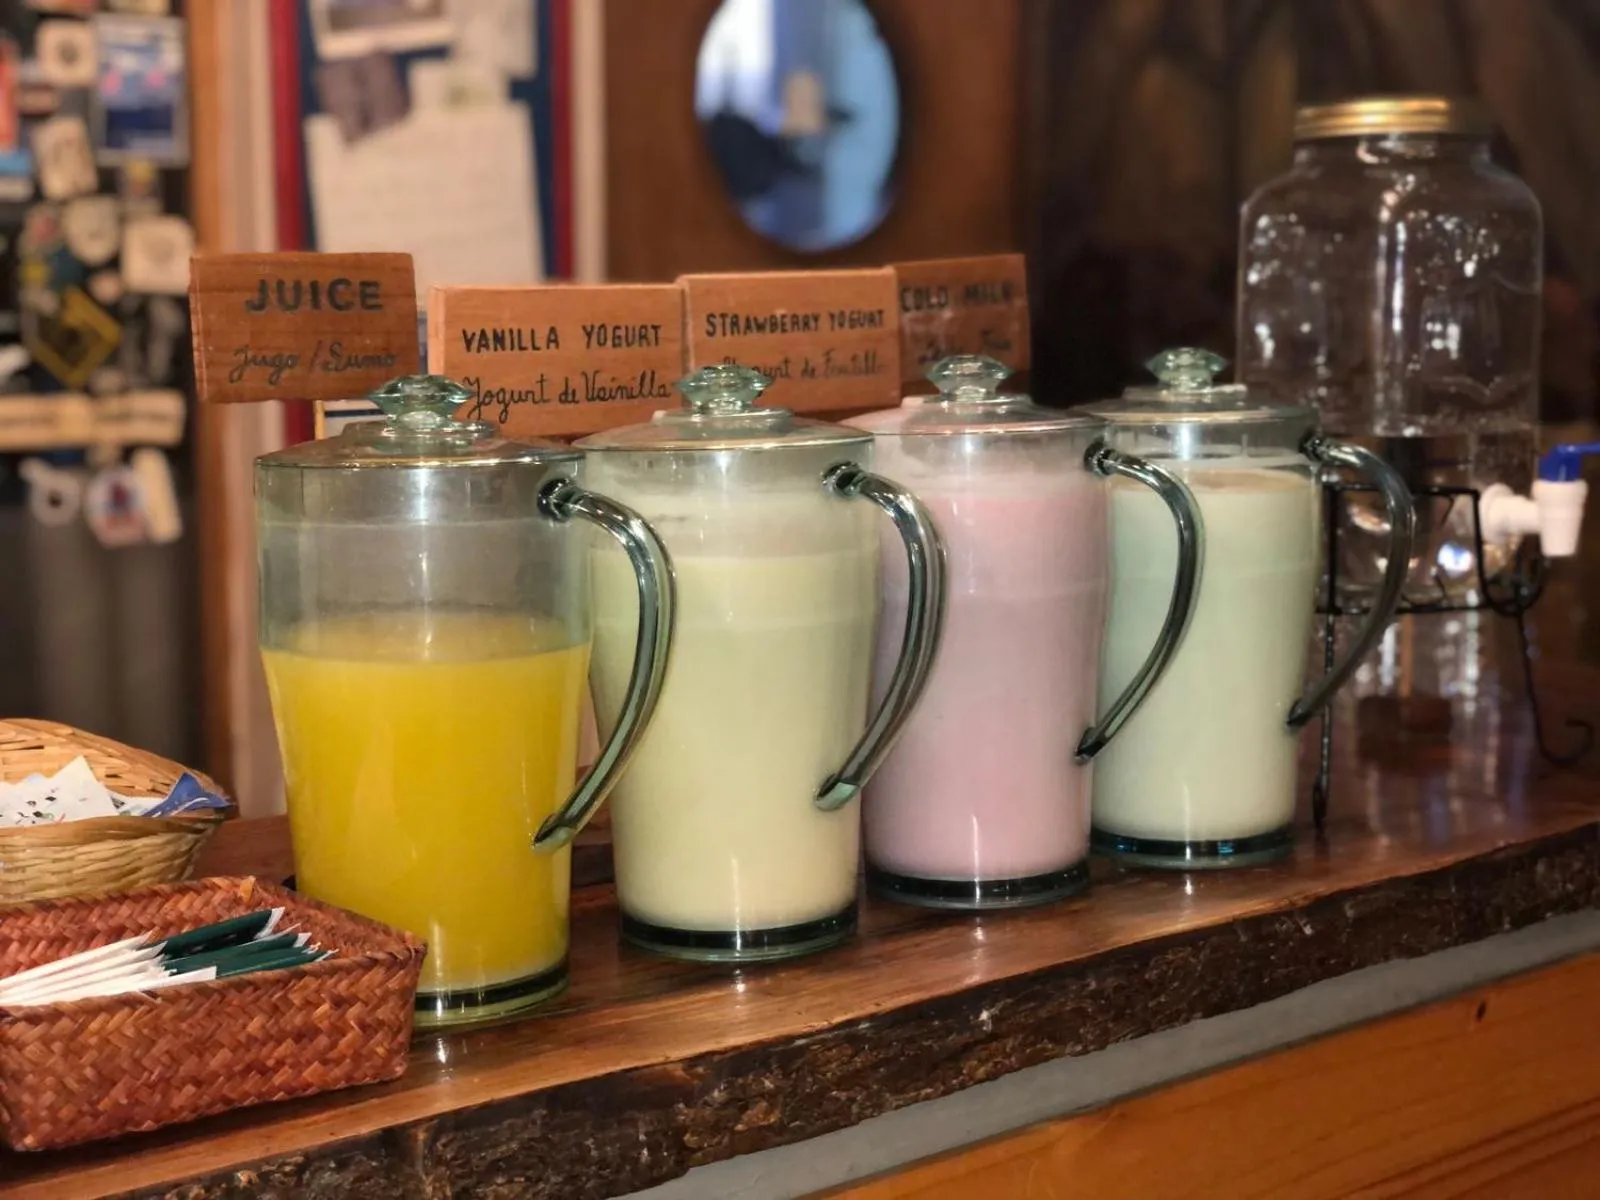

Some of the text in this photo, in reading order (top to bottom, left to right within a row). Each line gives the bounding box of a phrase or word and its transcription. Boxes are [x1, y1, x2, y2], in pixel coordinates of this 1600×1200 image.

[245, 277, 383, 312] JUICE
[461, 324, 662, 353] VANILLA YOGURT
[705, 308, 885, 338] STRAWBERRY YOGURT
[228, 344, 299, 386] Jugo
[463, 370, 672, 424] Yogurt de Vainilla
